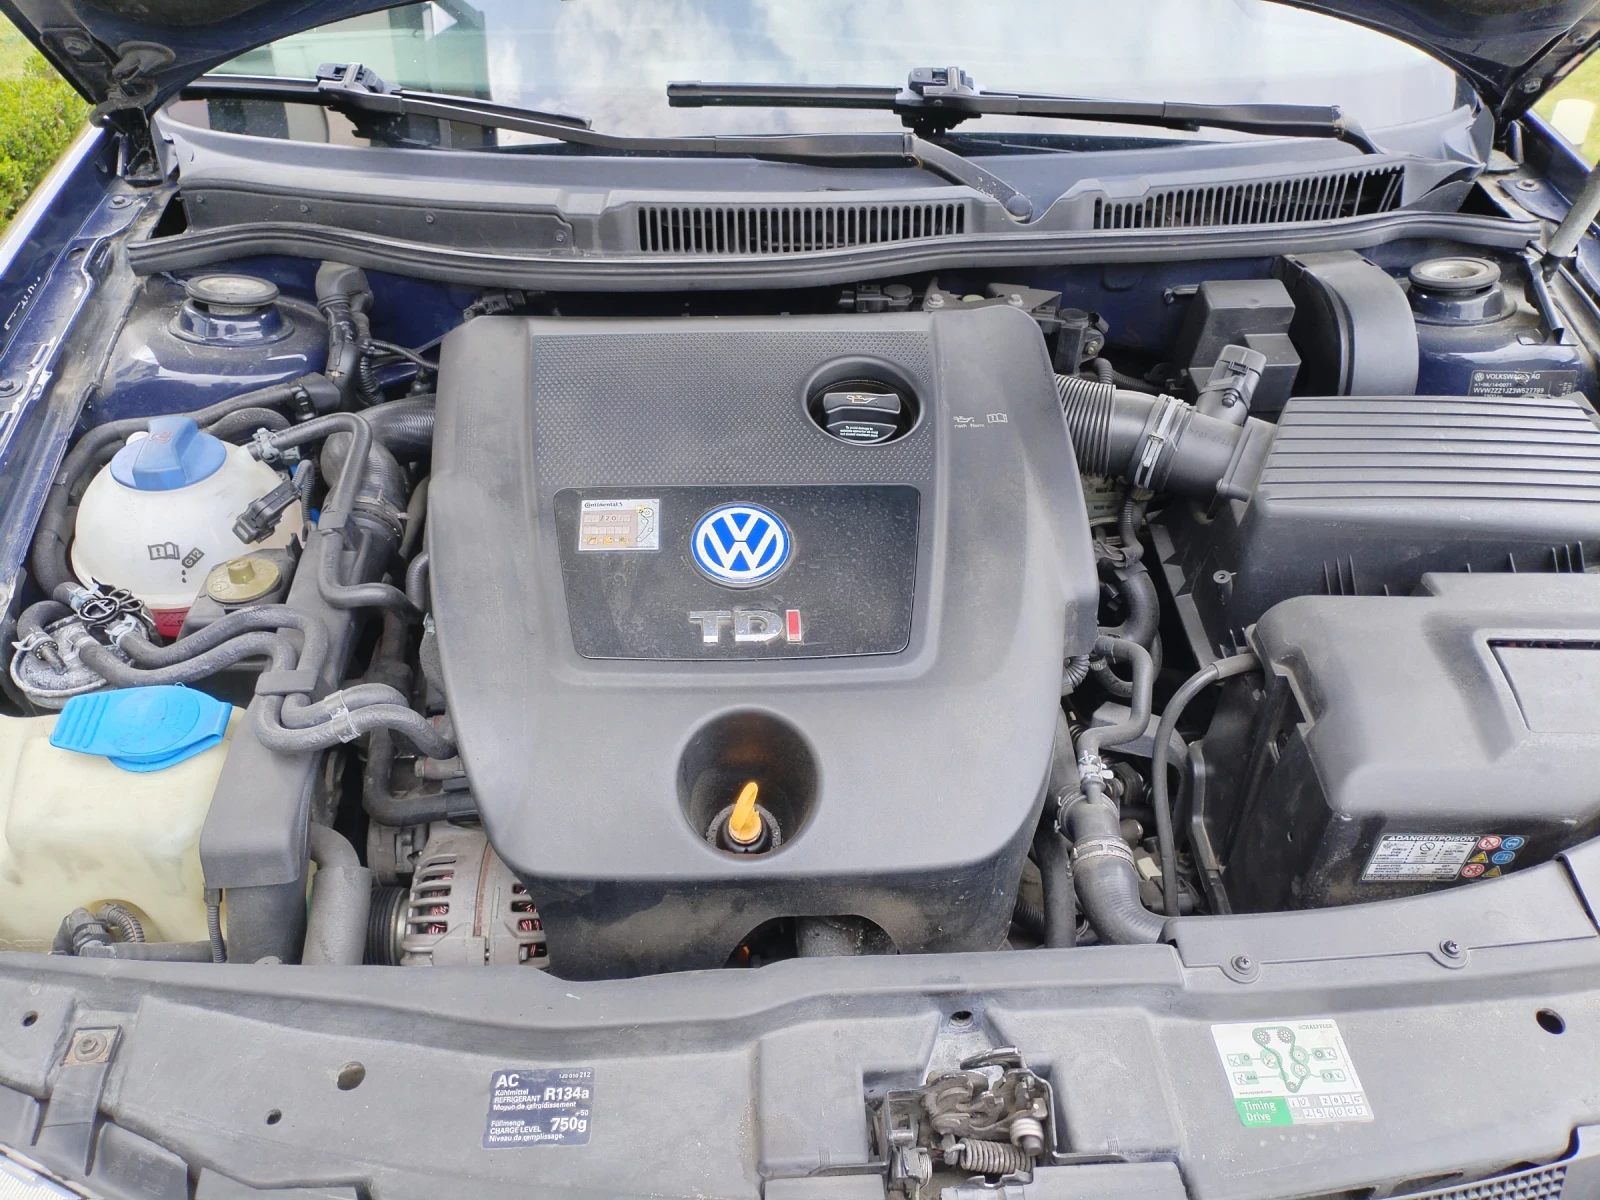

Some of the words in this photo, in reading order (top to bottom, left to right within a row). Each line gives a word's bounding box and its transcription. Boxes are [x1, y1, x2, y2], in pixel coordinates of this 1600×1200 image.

[584, 501, 618, 509] Continental
[691, 502, 790, 583] VW
[184, 549, 204, 567] G12
[690, 609, 802, 643] TDI
[495, 1074, 519, 1088] AC
[494, 1095, 541, 1103] REFRIGERANT
[544, 1086, 590, 1102] R134a
[1242, 1099, 1277, 1112] Timing
[1246, 1111, 1272, 1122] Drive
[550, 1116, 588, 1133] 750g
[489, 1134, 513, 1143] Niveau
[513, 1133, 522, 1141] de
